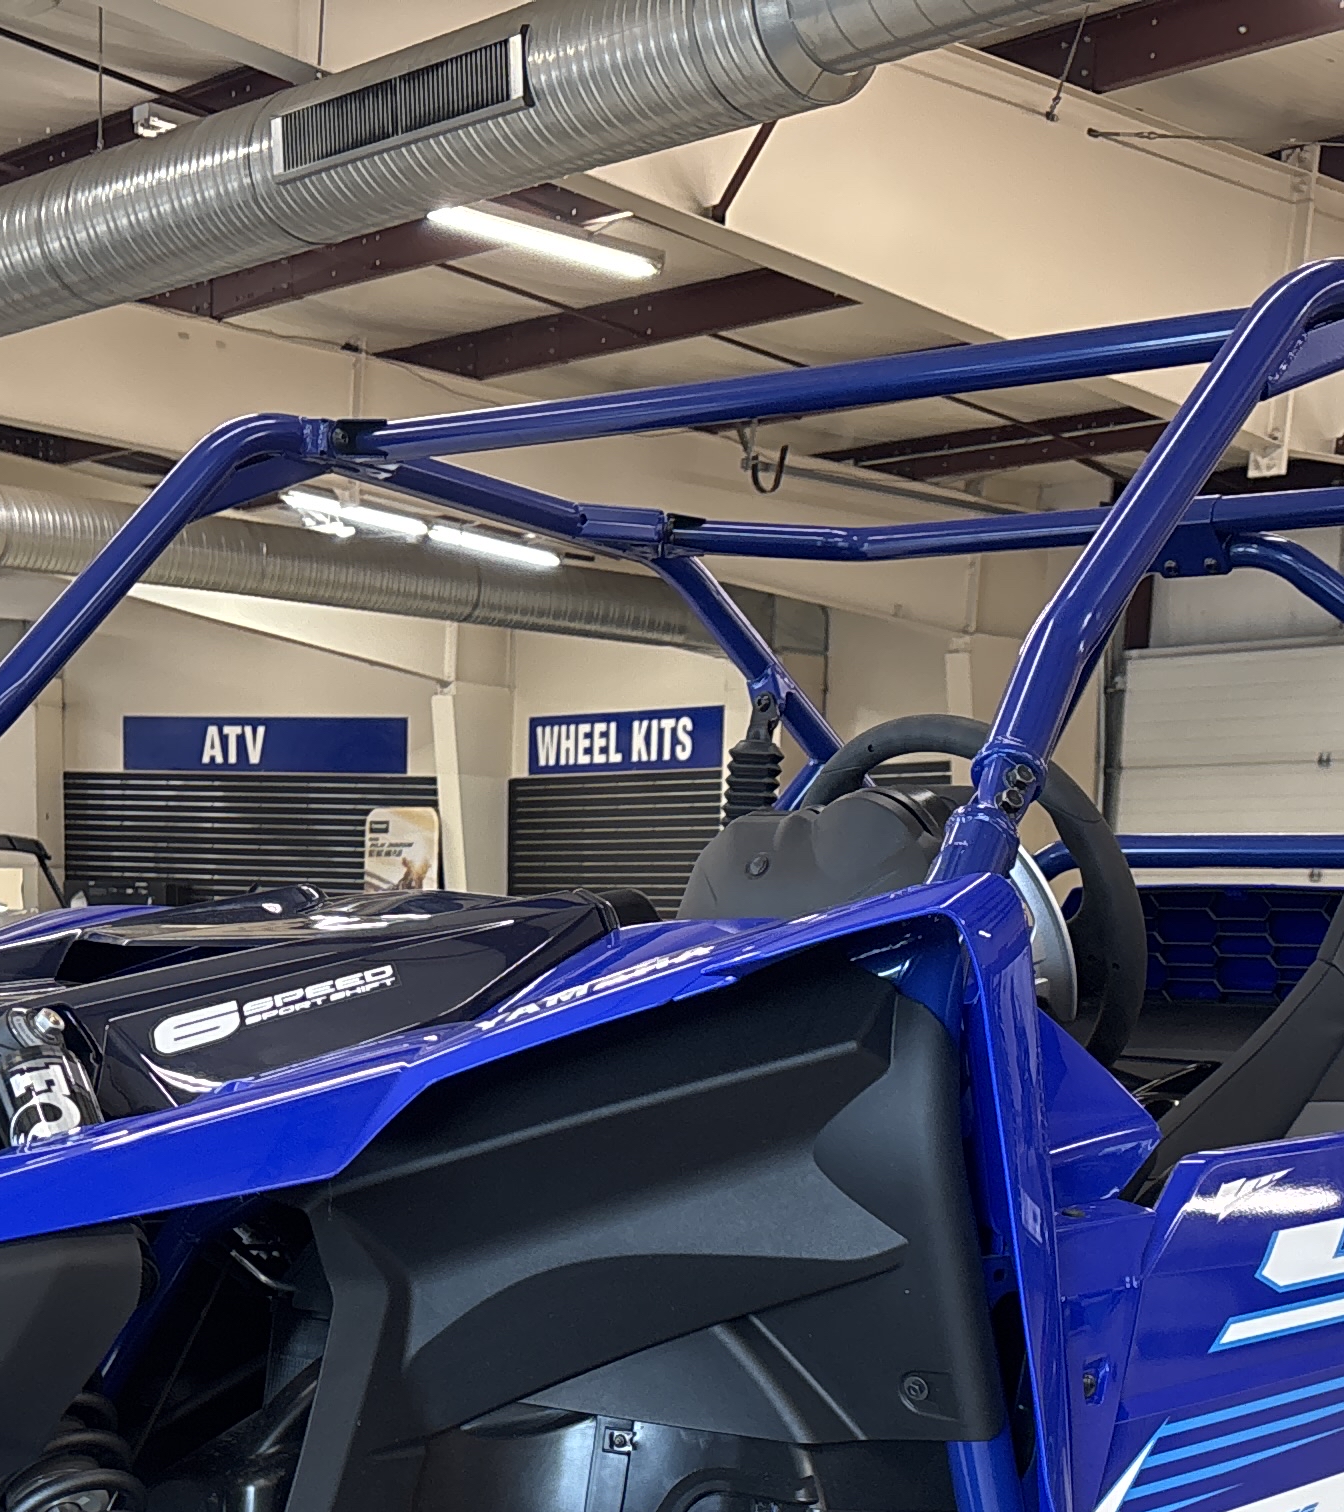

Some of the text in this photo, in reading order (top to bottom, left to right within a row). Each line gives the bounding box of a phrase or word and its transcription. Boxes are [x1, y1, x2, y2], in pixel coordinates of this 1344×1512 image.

[201, 724, 265, 766] ATV
[536, 717, 693, 767] WHEEL KITS
[242, 963, 395, 1017] SPEED
